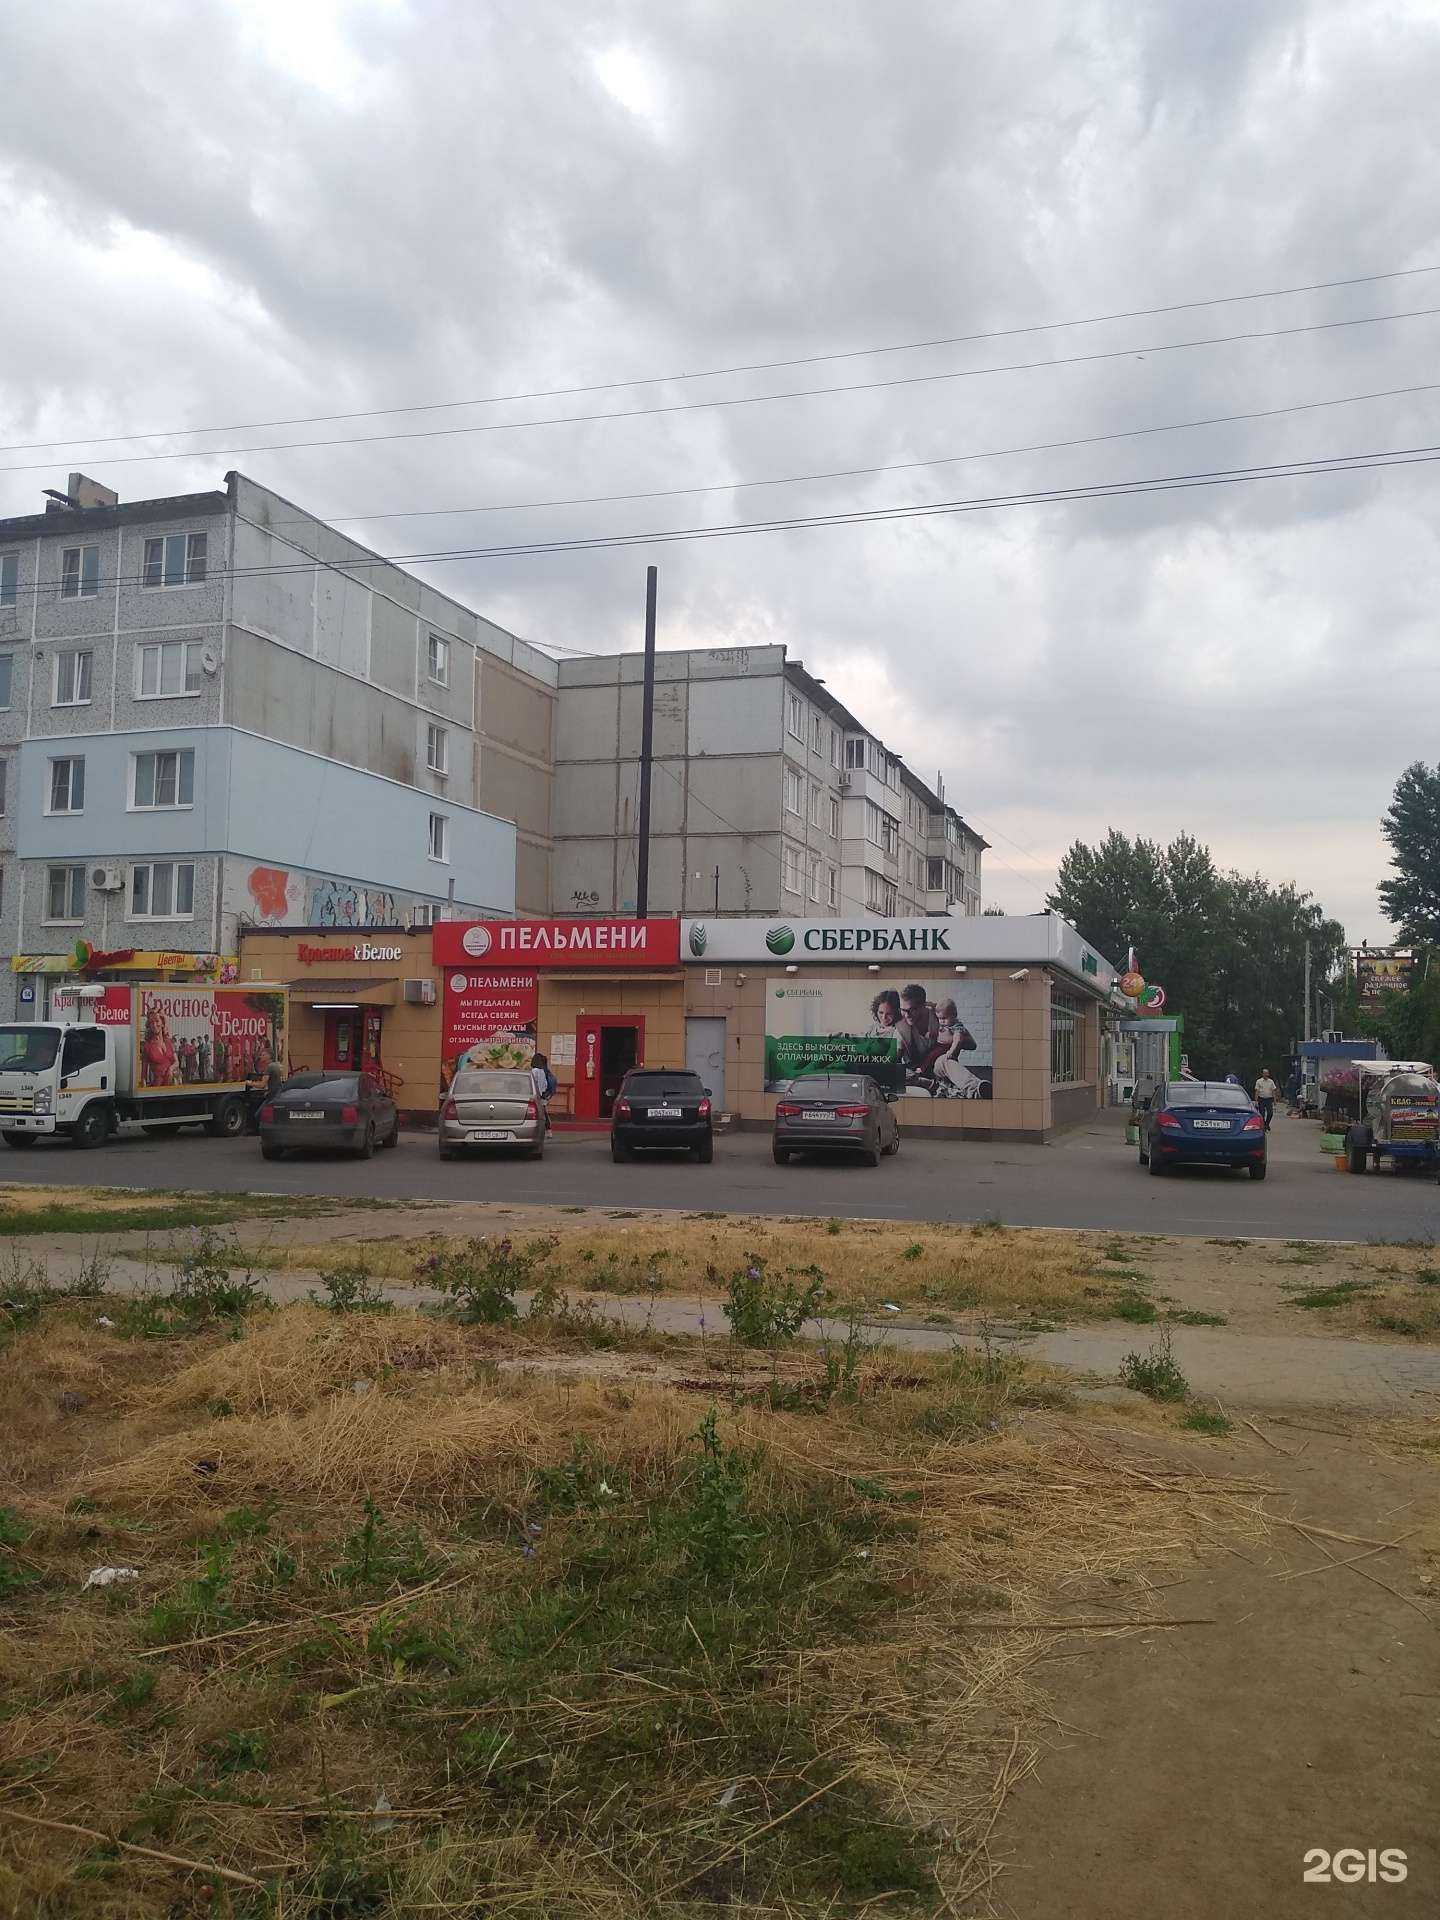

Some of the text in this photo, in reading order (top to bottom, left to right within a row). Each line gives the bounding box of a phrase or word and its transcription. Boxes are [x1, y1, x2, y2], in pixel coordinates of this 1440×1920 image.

[500, 926, 647, 949] ПЕЛЬМЕНИ
[804, 928, 950, 951] СБЕРБАНК
[362, 944, 401, 960] Белое
[469, 977, 533, 988] ПЕЛЬМЕНИ
[141, 991, 209, 1017] Красное
[100, 1005, 129, 1020] Белое
[221, 1011, 266, 1036] Белое
[777, 1043, 856, 1052] ЗДЕСЬ ВЫ МОЖЕТЕ
[776, 1053, 833, 1062] ОПЛАЧИВАТЬ
